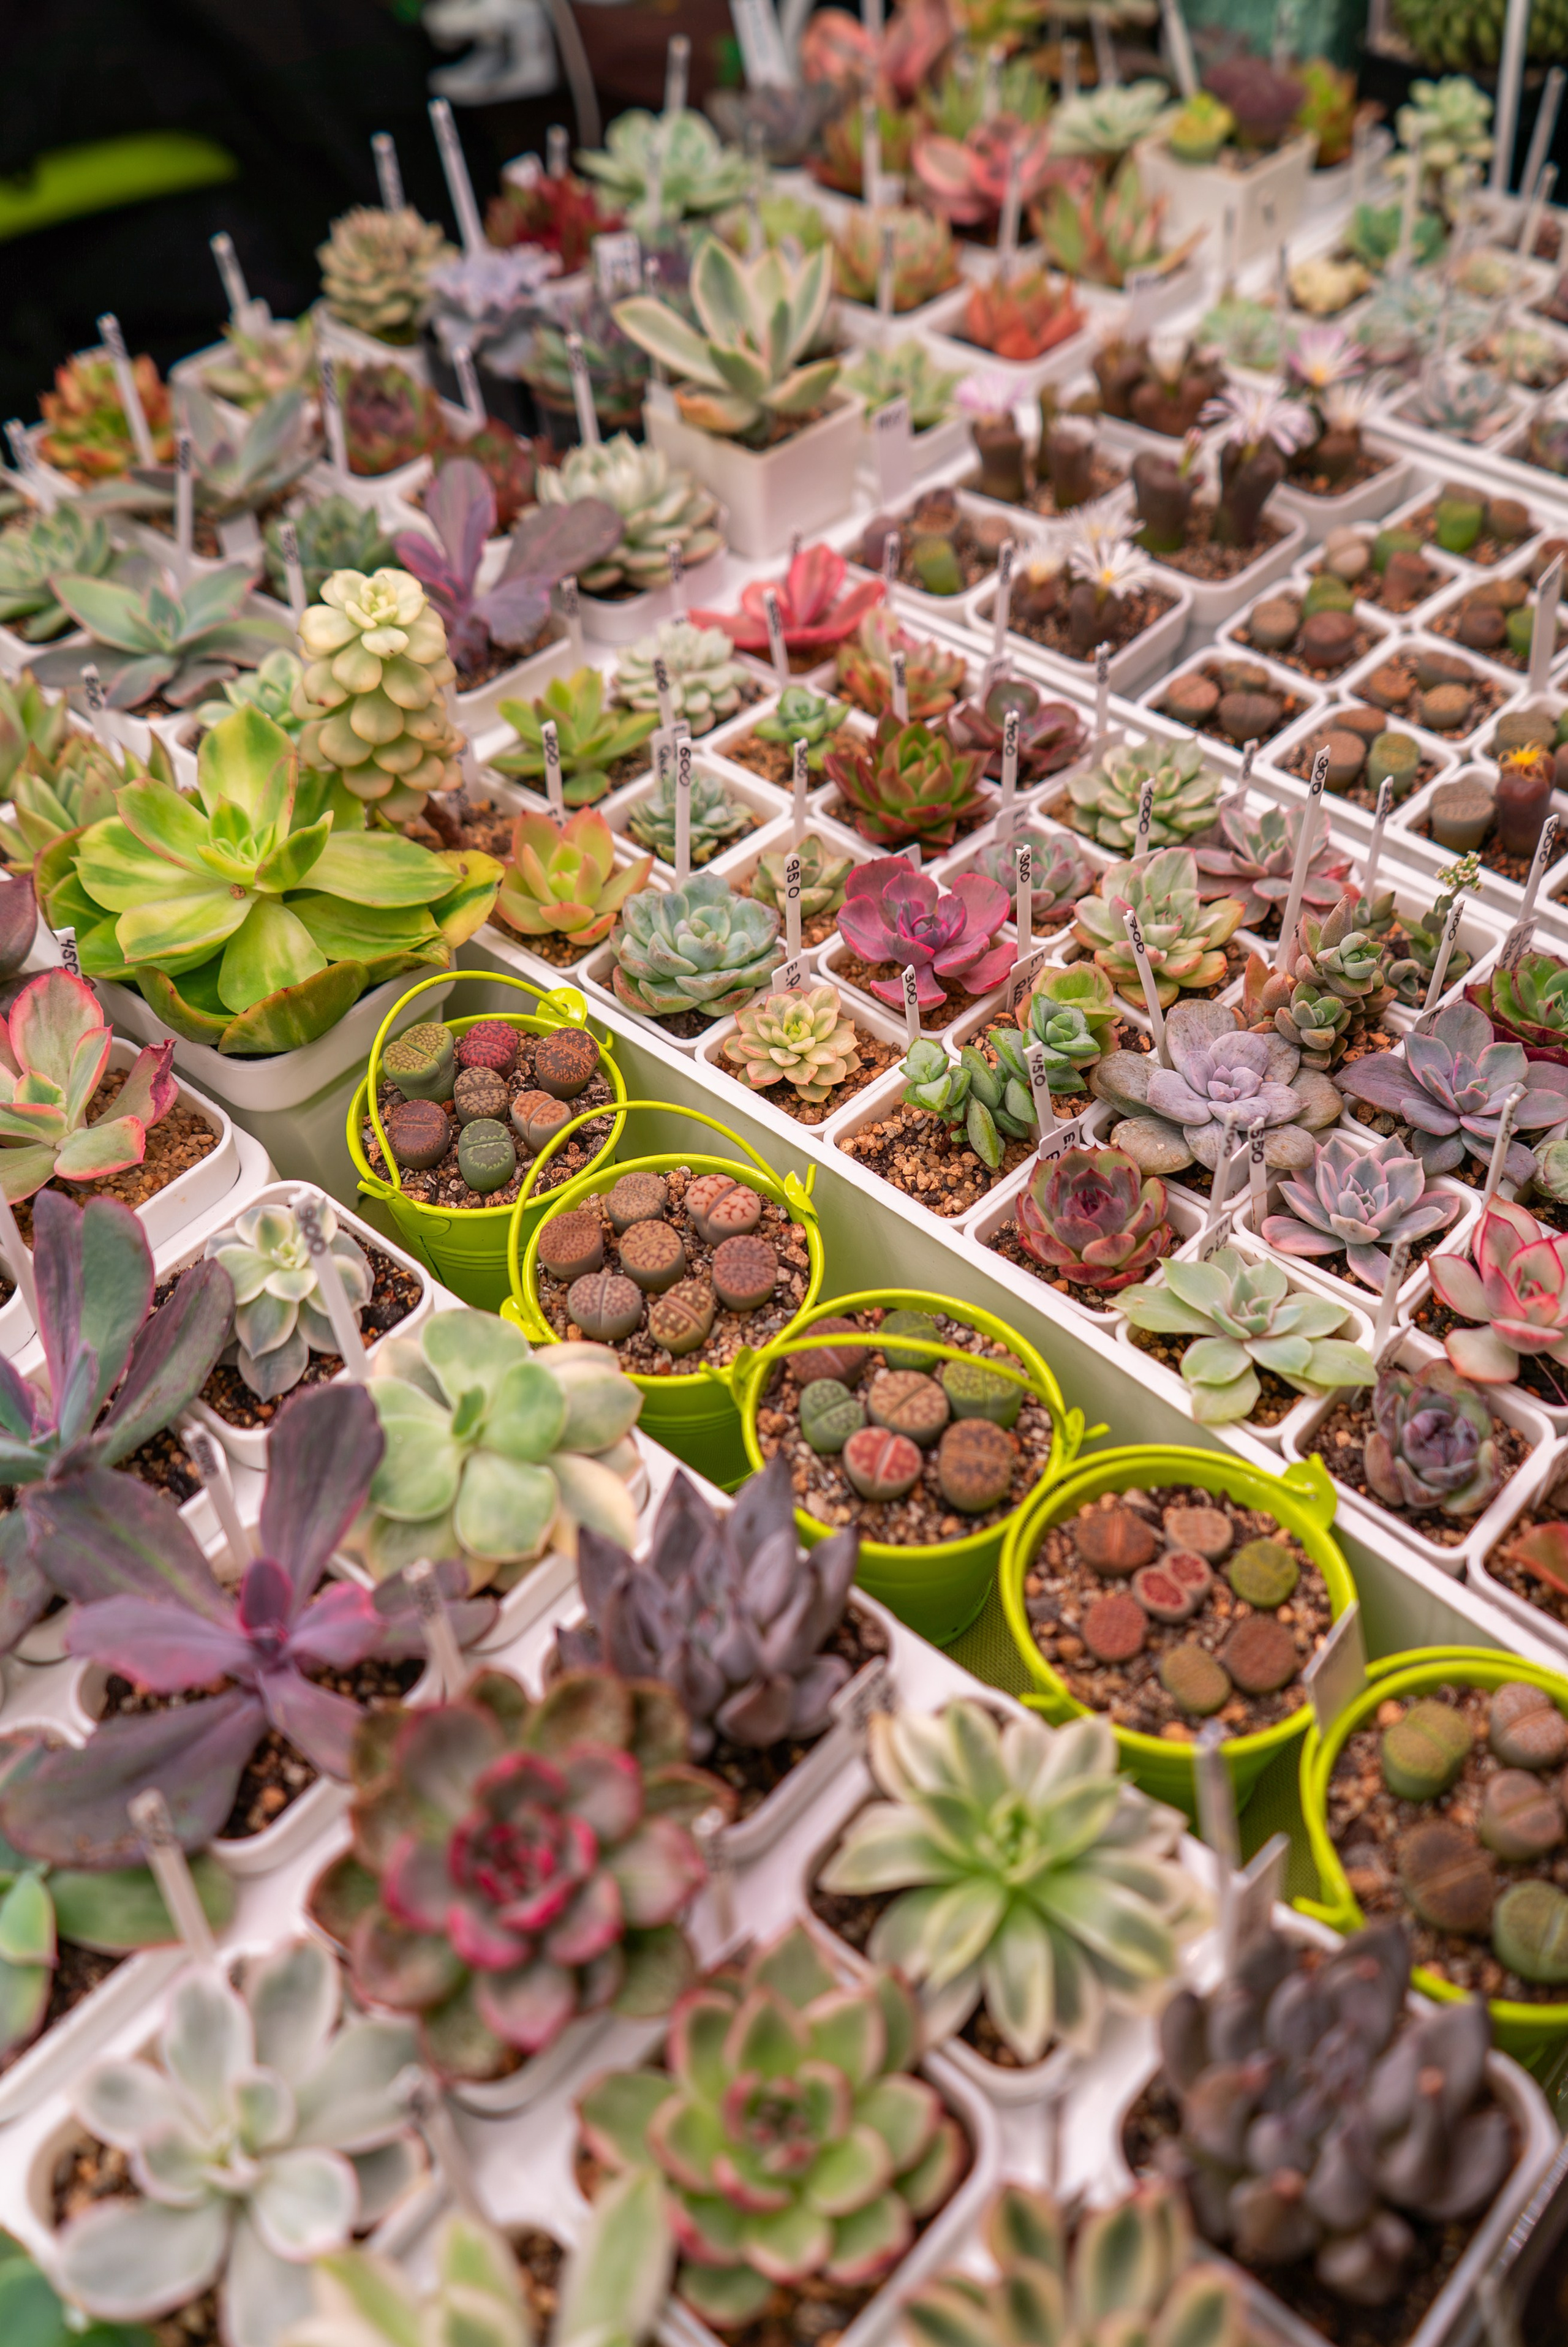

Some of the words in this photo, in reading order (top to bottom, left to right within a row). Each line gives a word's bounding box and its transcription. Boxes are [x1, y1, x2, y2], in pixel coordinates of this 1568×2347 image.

[679, 747, 691, 786] 600
[1312, 756, 1329, 795] 300
[1139, 787, 1153, 835] 1000
[1539, 821, 1557, 863] 300
[786, 859, 800, 898] 950
[1020, 854, 1030, 883] 300
[1129, 916, 1145, 954] 700
[1448, 906, 1463, 941] 400
[61, 939, 79, 975] 450
[905, 973, 918, 1005] 300
[1031, 1053, 1046, 1087] 450
[1250, 1129, 1264, 1164] 550
[298, 1205, 328, 1256] 900
